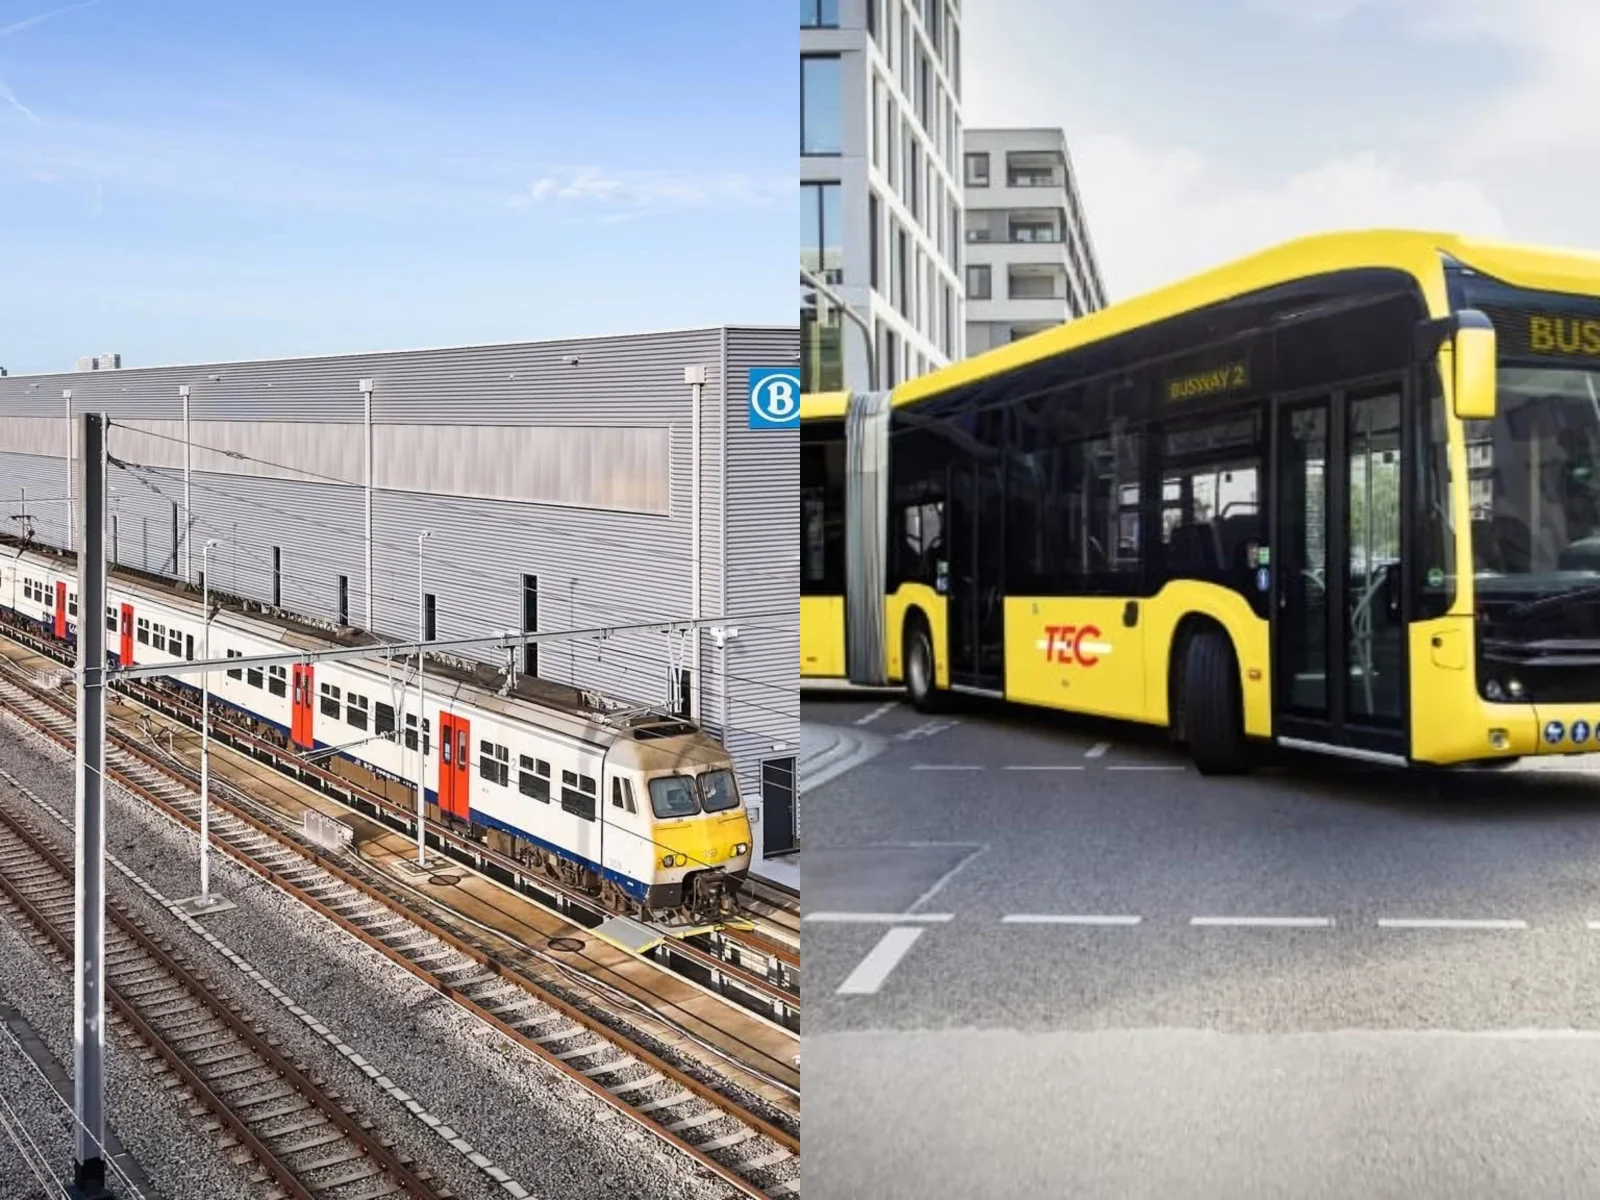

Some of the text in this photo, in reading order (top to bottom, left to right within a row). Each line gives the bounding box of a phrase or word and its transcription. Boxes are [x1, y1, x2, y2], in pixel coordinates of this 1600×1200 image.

[1529, 316, 1600, 352] BUS
[1231, 365, 1245, 386] 2
[767, 381, 794, 415] B
[1045, 625, 1101, 668] TEC
